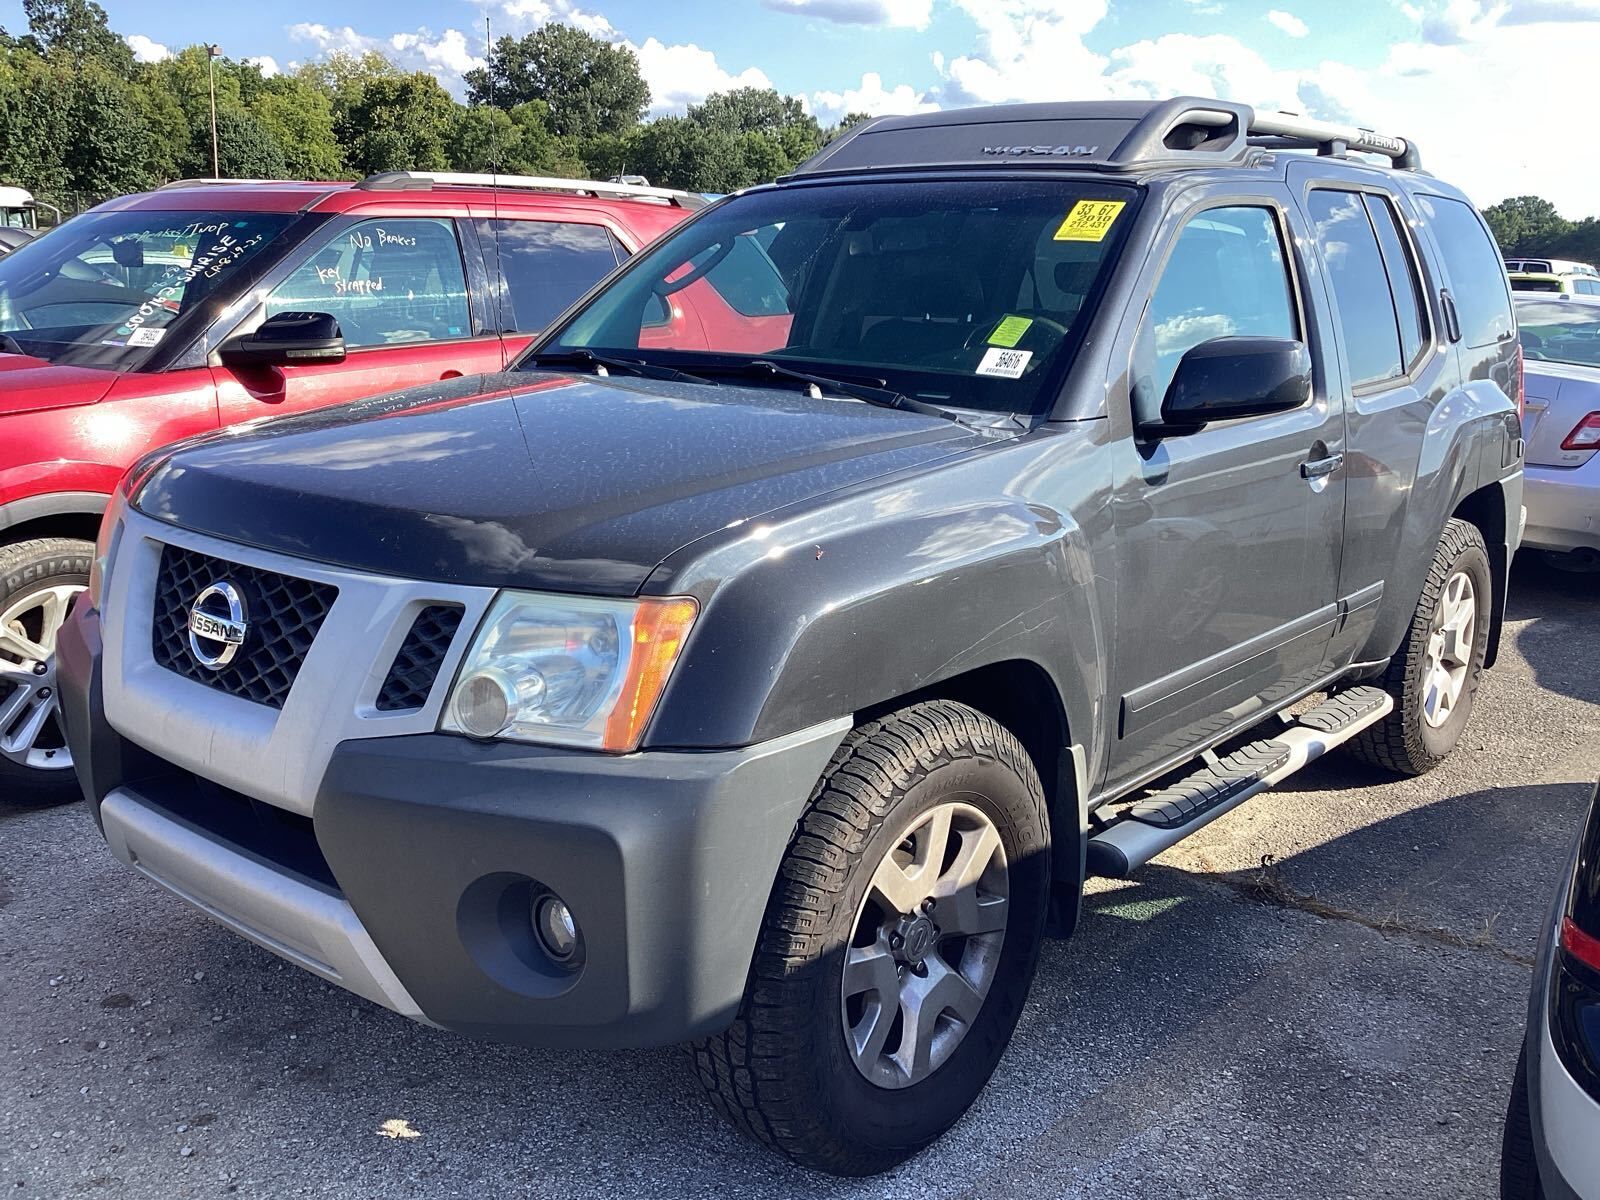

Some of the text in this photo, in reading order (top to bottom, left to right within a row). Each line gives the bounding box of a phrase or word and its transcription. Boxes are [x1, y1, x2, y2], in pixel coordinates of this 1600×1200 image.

[981, 145, 1099, 157] NISSAN
[1077, 203, 1117, 216] 33 67
[1068, 220, 1108, 229] 212,431
